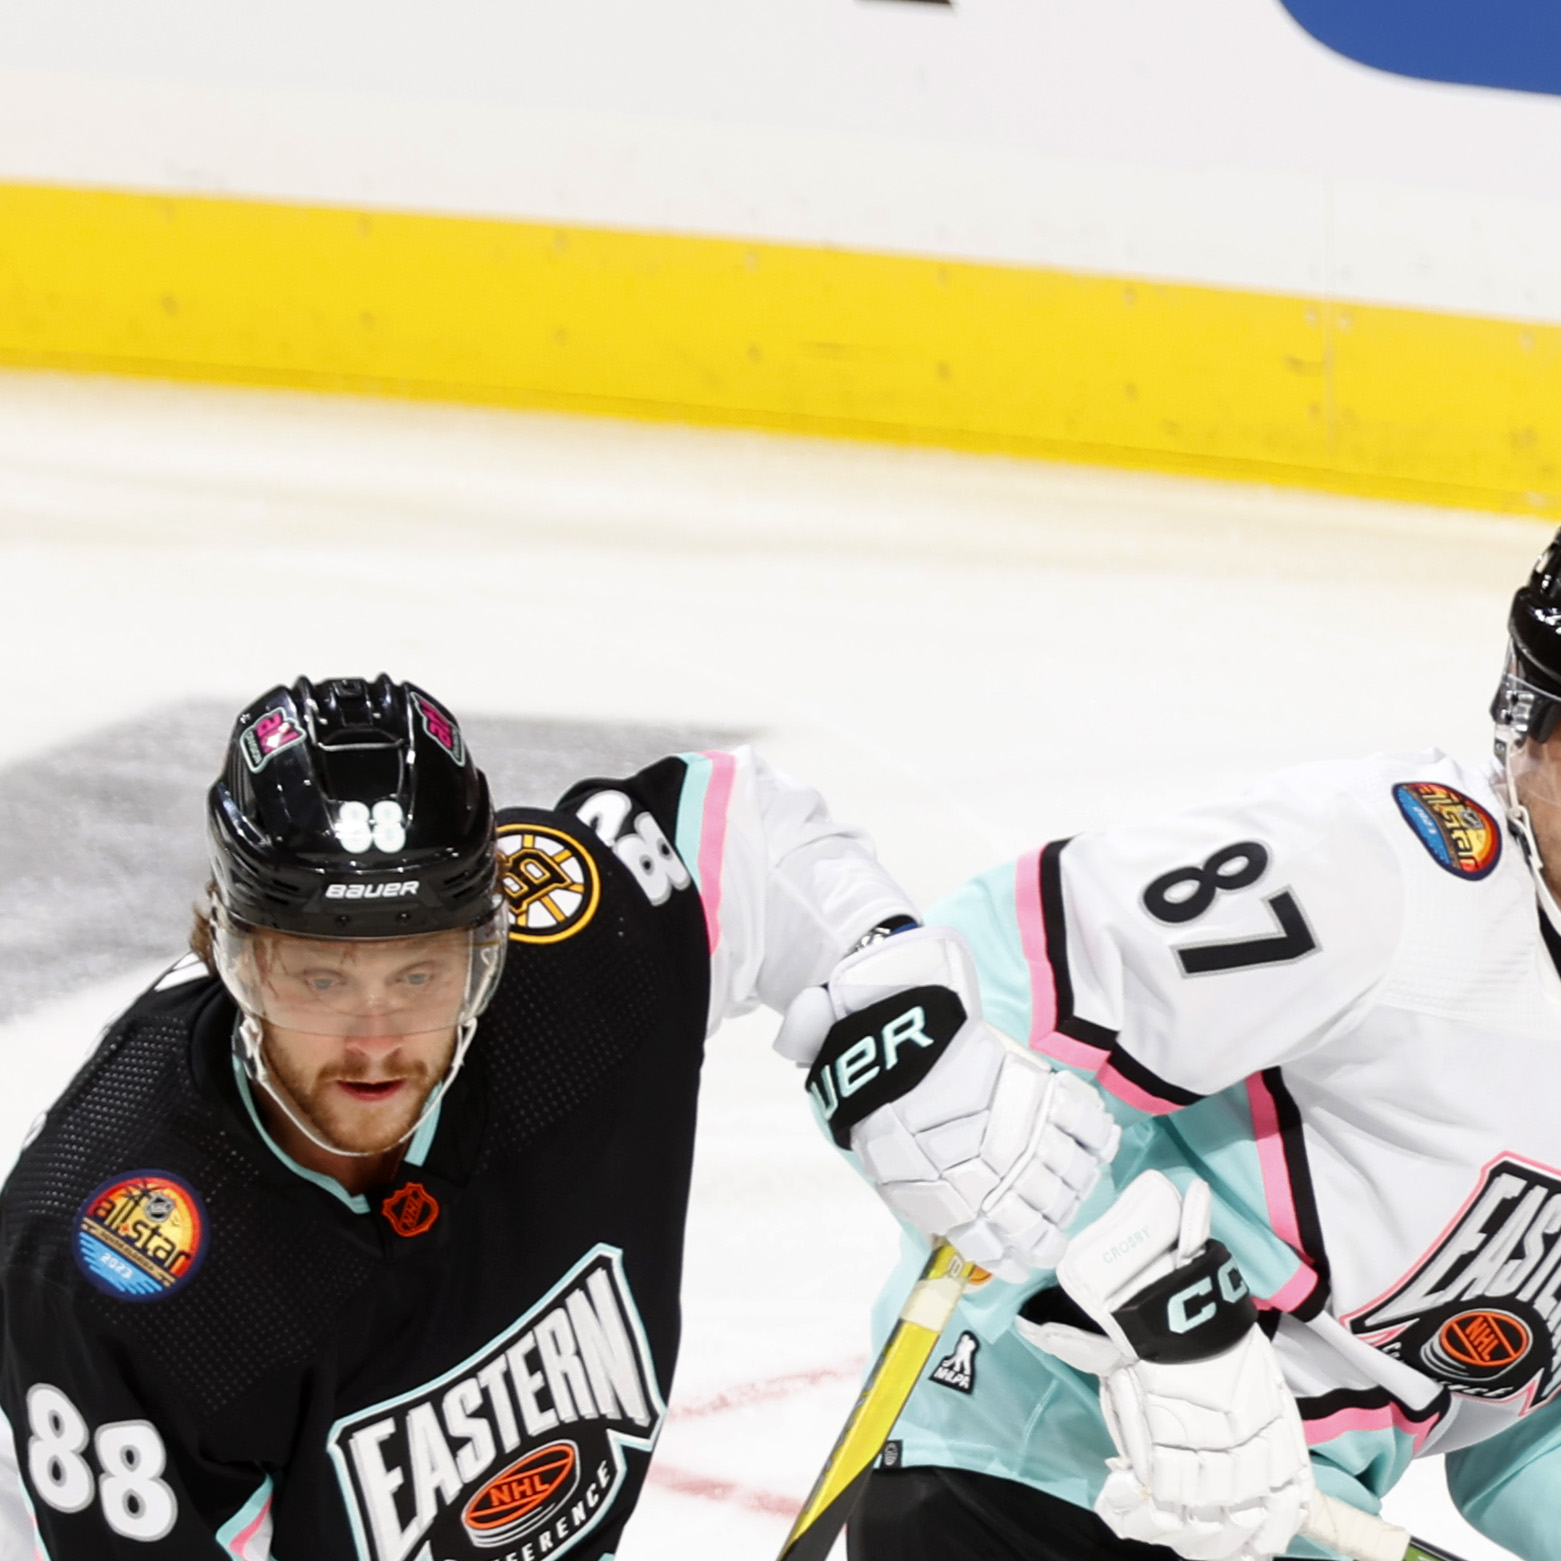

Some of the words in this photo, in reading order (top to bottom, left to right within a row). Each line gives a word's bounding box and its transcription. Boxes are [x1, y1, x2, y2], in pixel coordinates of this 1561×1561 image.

[340, 800, 405, 853] 88
[325, 881, 420, 899] BAUER
[1139, 838, 1325, 980] 87
[100, 1252, 133, 1279] 2023
[1102, 1227, 1151, 1265] CROSBY
[1465, 1315, 1499, 1363] NHL
[26, 1382, 178, 1542] 88
[488, 1473, 551, 1507] NHL
